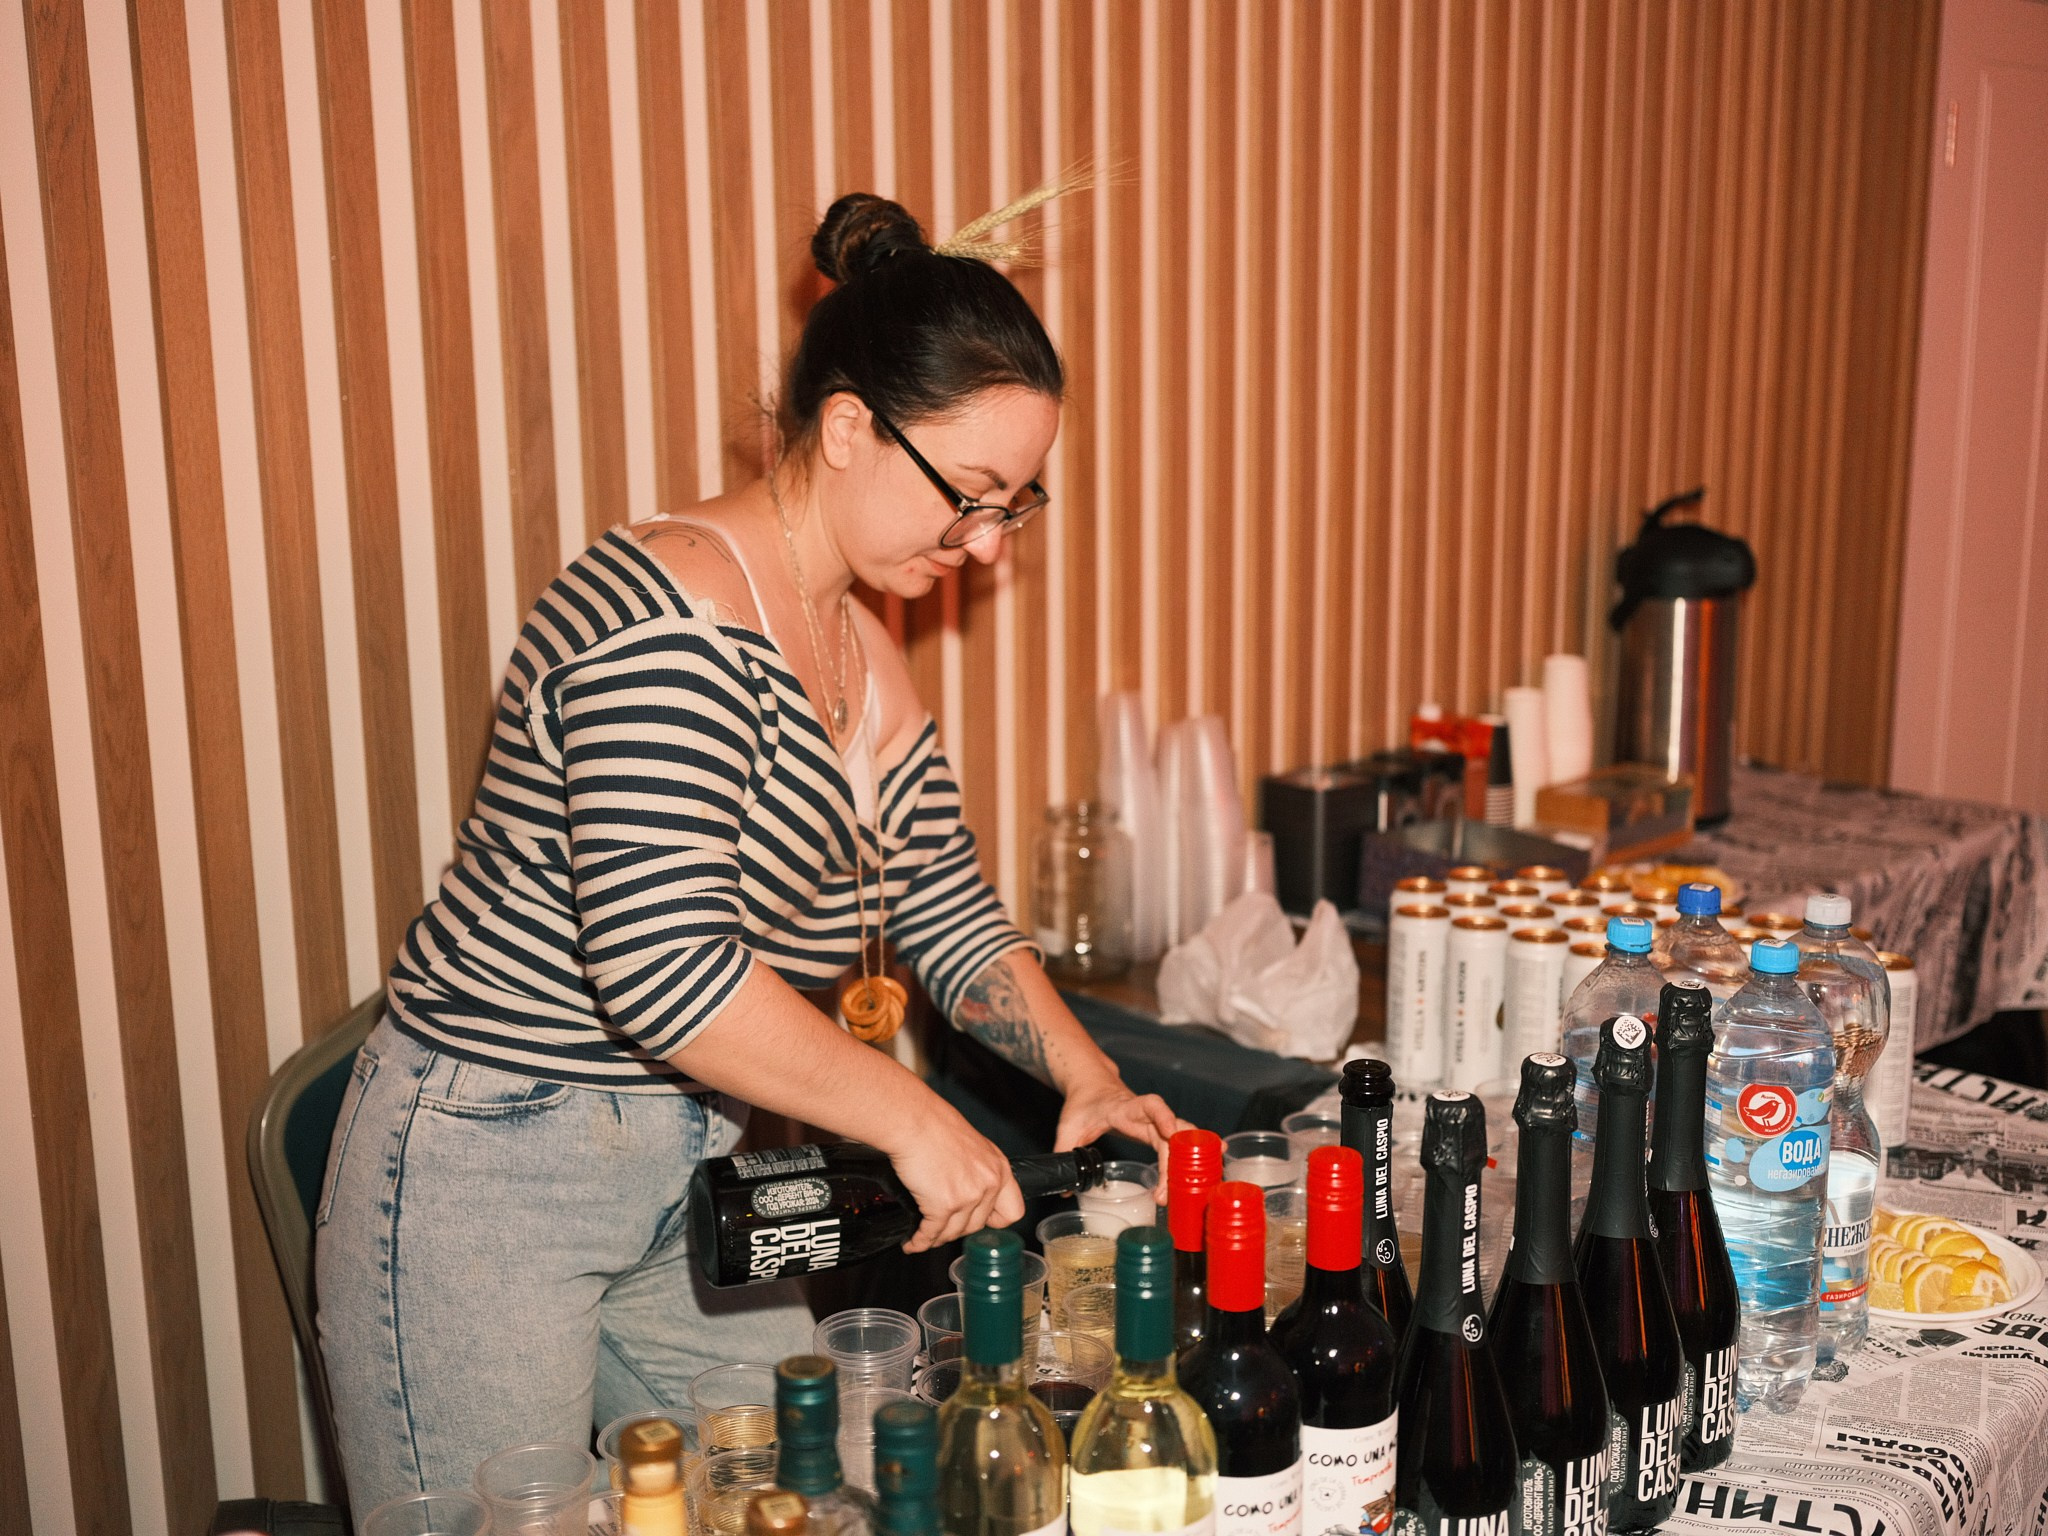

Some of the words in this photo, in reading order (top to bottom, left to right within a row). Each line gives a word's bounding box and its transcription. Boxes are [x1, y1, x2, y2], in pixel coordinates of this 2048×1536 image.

[1376, 1118, 1388, 1160] CASPIO
[1782, 1137, 1821, 1165] ВОДА
[1375, 1162, 1388, 1185] DEL
[1375, 1188, 1388, 1219] LUNA
[1463, 1183, 1478, 1227] CASPIO
[780, 1222, 812, 1266] DEL
[807, 1218, 840, 1272] LUNA
[1462, 1228, 1476, 1253] DEL
[1823, 1218, 1872, 1247] НЕЖС
[1462, 1256, 1476, 1295] LUNA
[1704, 1342, 1739, 1384] LUN
[1702, 1376, 1735, 1415] DEL
[1612, 1426, 1622, 1442] 2024
[1700, 1405, 1735, 1444] CAS
[1309, 1453, 1358, 1467] COMO
[1639, 1430, 1676, 1471] DEL
[1837, 1433, 1974, 1505] свободы
[1610, 1470, 1620, 1483] ГОД
[1861, 1455, 1954, 1523] Певец
[1224, 1501, 1273, 1517] COMO
[1564, 1485, 1604, 1529] DEL
[1679, 1480, 1886, 1536] СТИН
